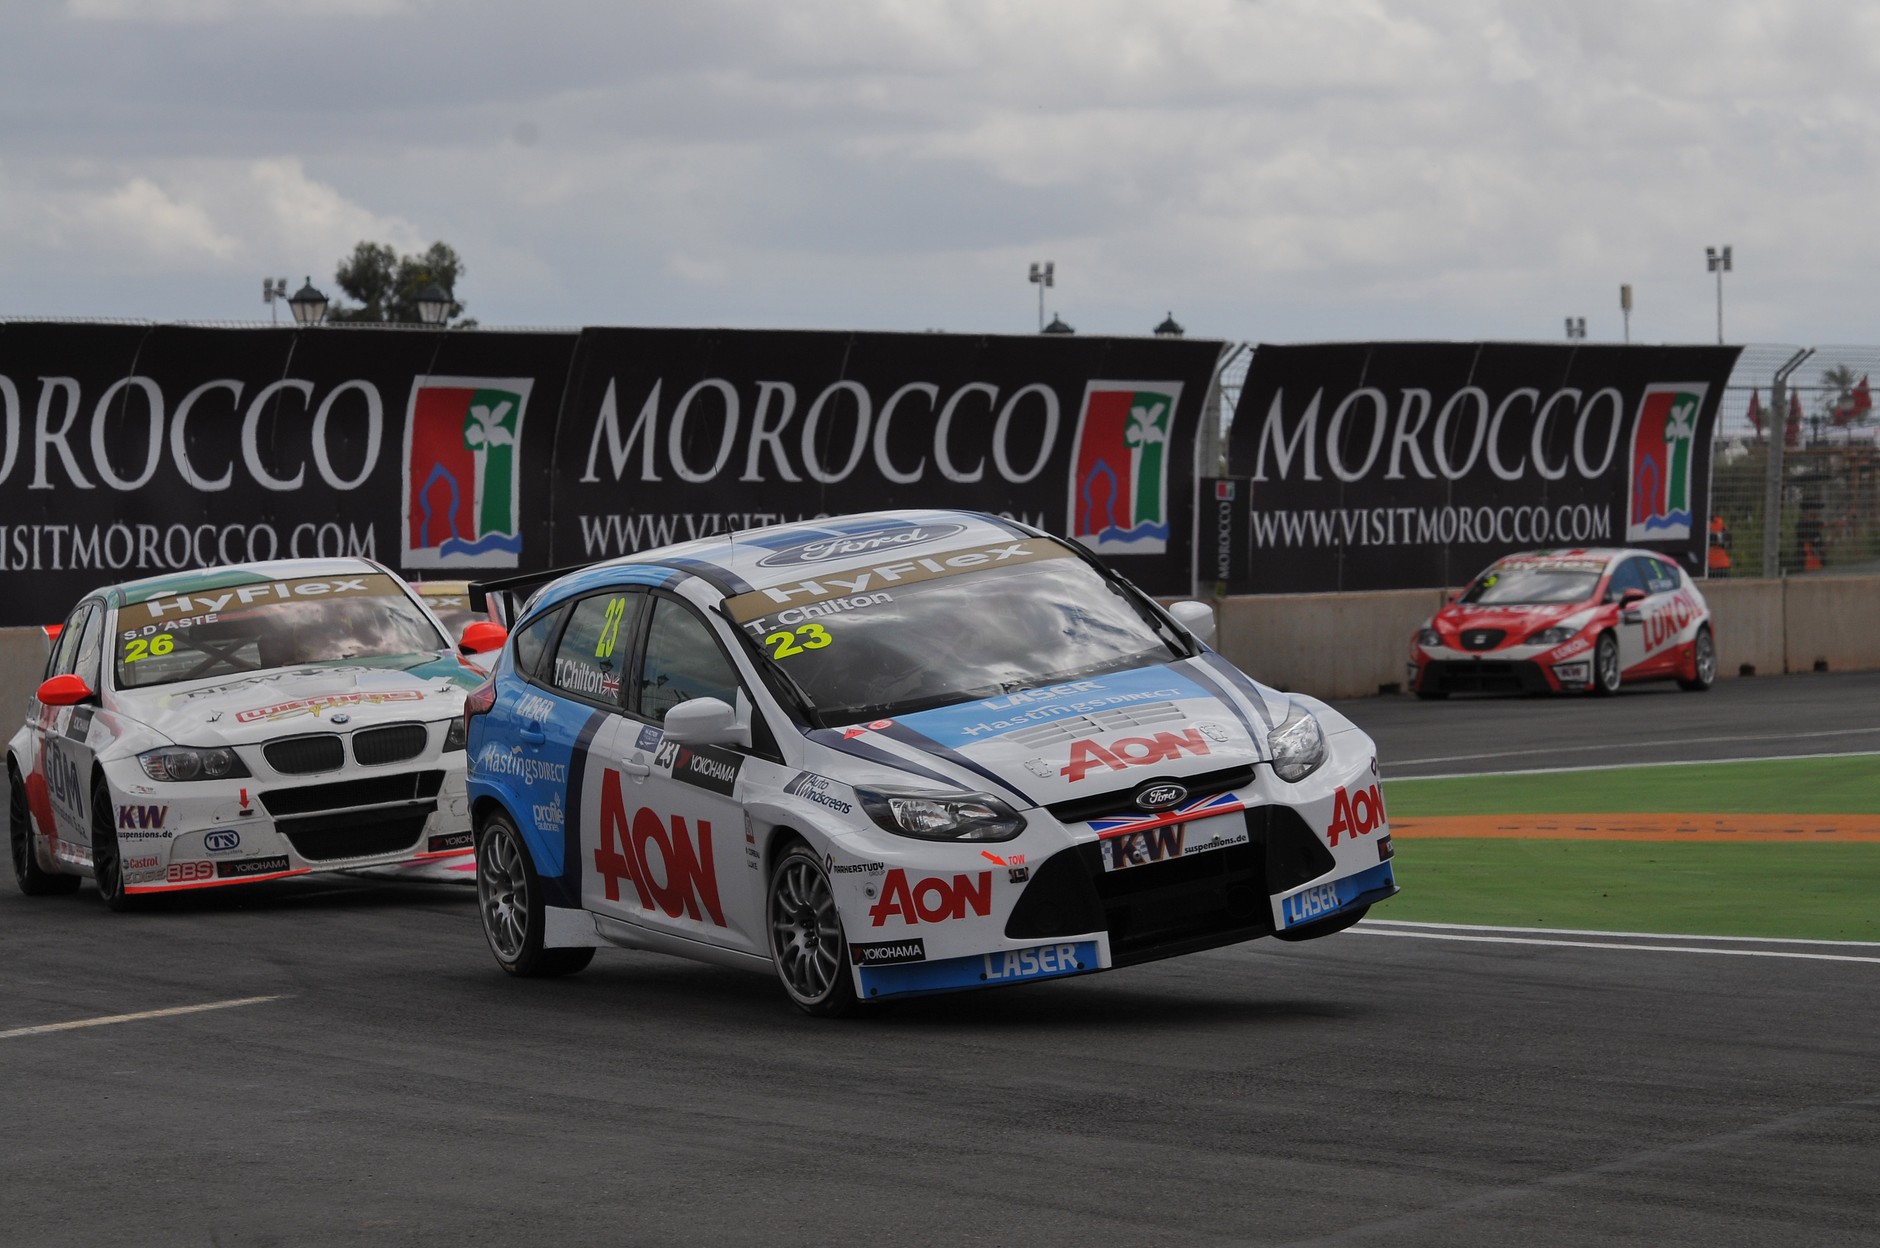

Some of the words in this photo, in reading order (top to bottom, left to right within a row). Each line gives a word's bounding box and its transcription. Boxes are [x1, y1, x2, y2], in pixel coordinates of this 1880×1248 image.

[0, 374, 384, 491] ROCCO
[580, 377, 1060, 484] MOROCCO
[1255, 386, 1623, 482] MOROCCO
[1218, 502, 1231, 579] MOROCCO
[1252, 504, 1611, 549] WWW.VISITMOROCCO.COM
[800, 528, 929, 561] Ford
[762, 544, 1033, 603] HyFlex
[147, 578, 369, 618] HyFlex
[595, 597, 626, 658] 23
[765, 623, 833, 660] 23
[124, 633, 175, 664] 26
[517, 693, 555, 724] LASER
[981, 680, 1105, 711] LASER
[654, 741, 680, 769] 23
[690, 754, 735, 783] YOKOHAMA
[808, 774, 829, 790] Auto
[1149, 788, 1176, 804] Ford
[800, 785, 853, 815] Windscreens
[118, 805, 168, 829] KW
[1008, 854, 1025, 865] TOW
[1111, 823, 1186, 870] KW
[1184, 834, 1247, 854] suspensions.de
[129, 856, 159, 868] Castrol
[167, 861, 214, 881] BBS
[235, 860, 288, 872] YOKOHAMA
[1291, 883, 1339, 921] LASER
[863, 944, 922, 960] YOKOHAMA
[984, 943, 1078, 979] LASER
